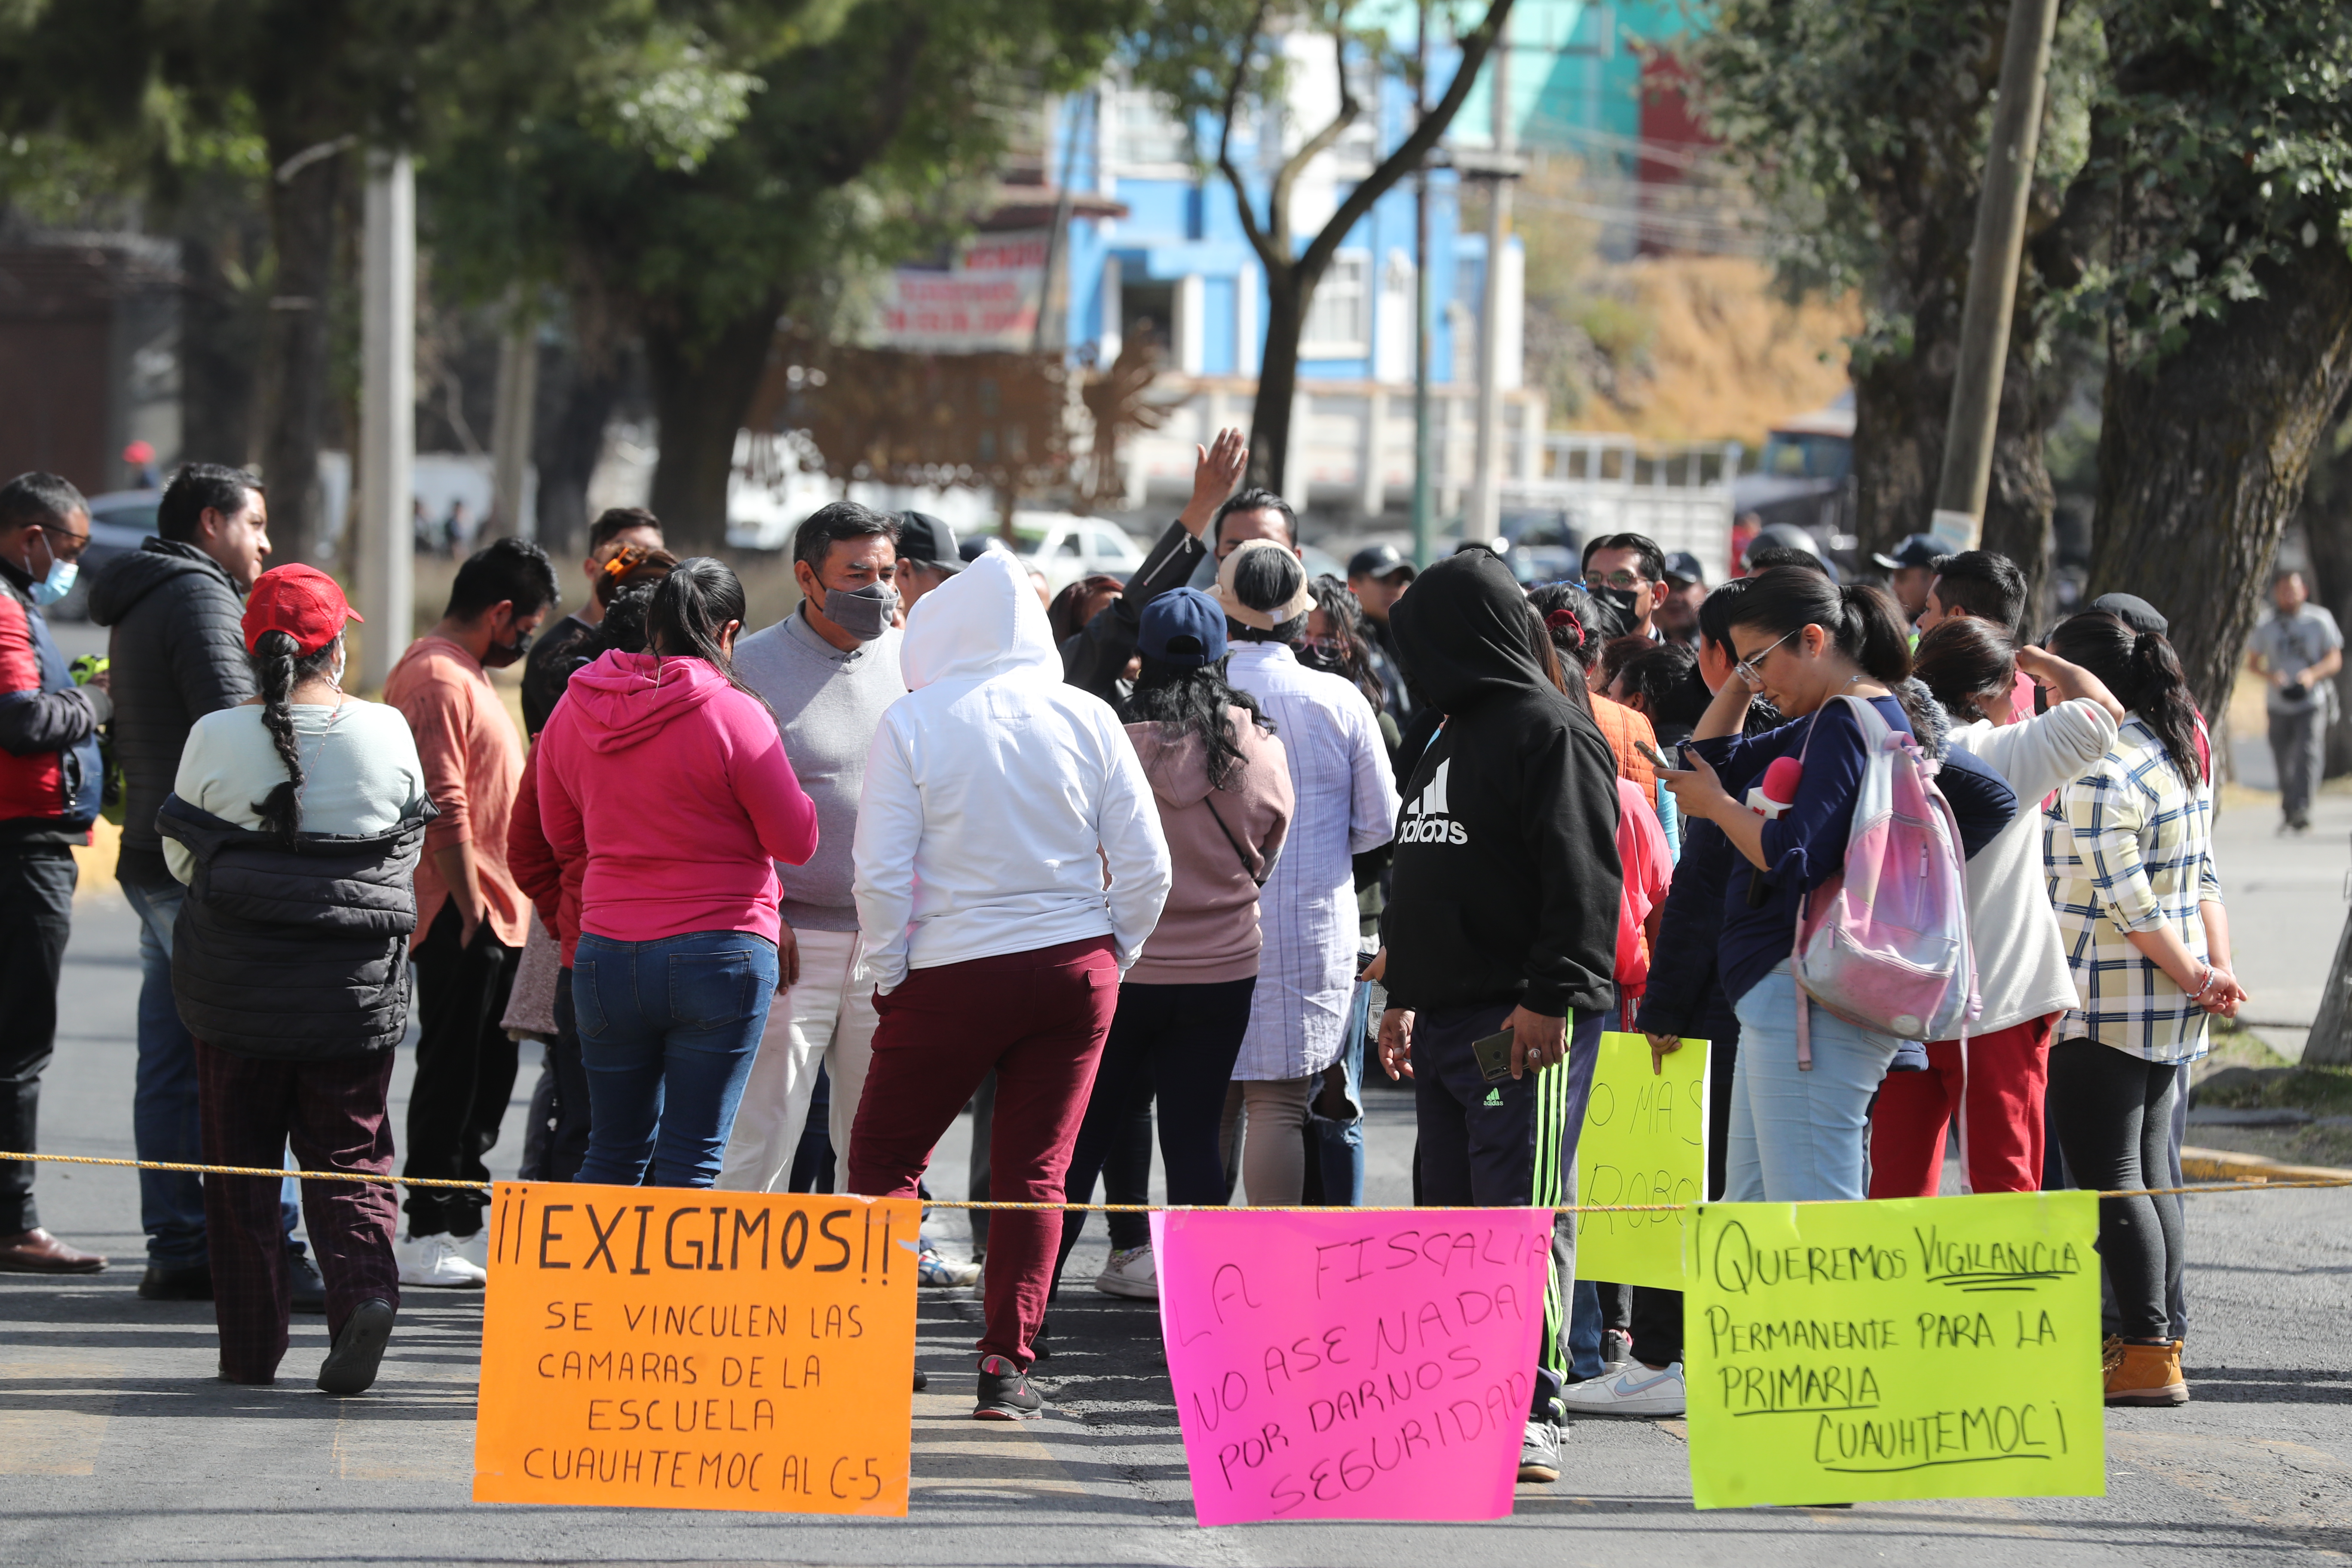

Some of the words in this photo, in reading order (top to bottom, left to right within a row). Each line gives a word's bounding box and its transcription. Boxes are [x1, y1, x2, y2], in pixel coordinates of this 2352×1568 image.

[1398, 813, 1468, 845] adidas
[1578, 1163, 1702, 1235] ROBO
[1173, 1264, 1262, 1347] LA
[1315, 1229, 1547, 1299] FISCALIA
[545, 1301, 593, 1331] SE
[624, 1304, 786, 1338] VINCULEN
[811, 1305, 863, 1338] LAS
[1705, 1305, 1899, 1359] PERMANENTE
[1917, 1312, 1994, 1349] PARA
[2016, 1309, 2056, 1348] LA
[538, 1350, 697, 1385] CAMARAS
[722, 1356, 764, 1388] DE
[784, 1355, 821, 1389] LA
[1193, 1371, 1248, 1442] NO
[1265, 1326, 1350, 1395] ASE
[1371, 1284, 1522, 1371] NADA
[1717, 1364, 1880, 1409] PRIMARIA
[589, 1398, 774, 1431] ESCUELA
[1218, 1422, 1289, 1491] POR
[1309, 1345, 1481, 1433] DARNOS
[1270, 1371, 1528, 1515] SEGURIDAD
[524, 1447, 763, 1492] CUAUHTEMOC
[782, 1455, 813, 1495] AL
[830, 1456, 881, 1501] C-5
